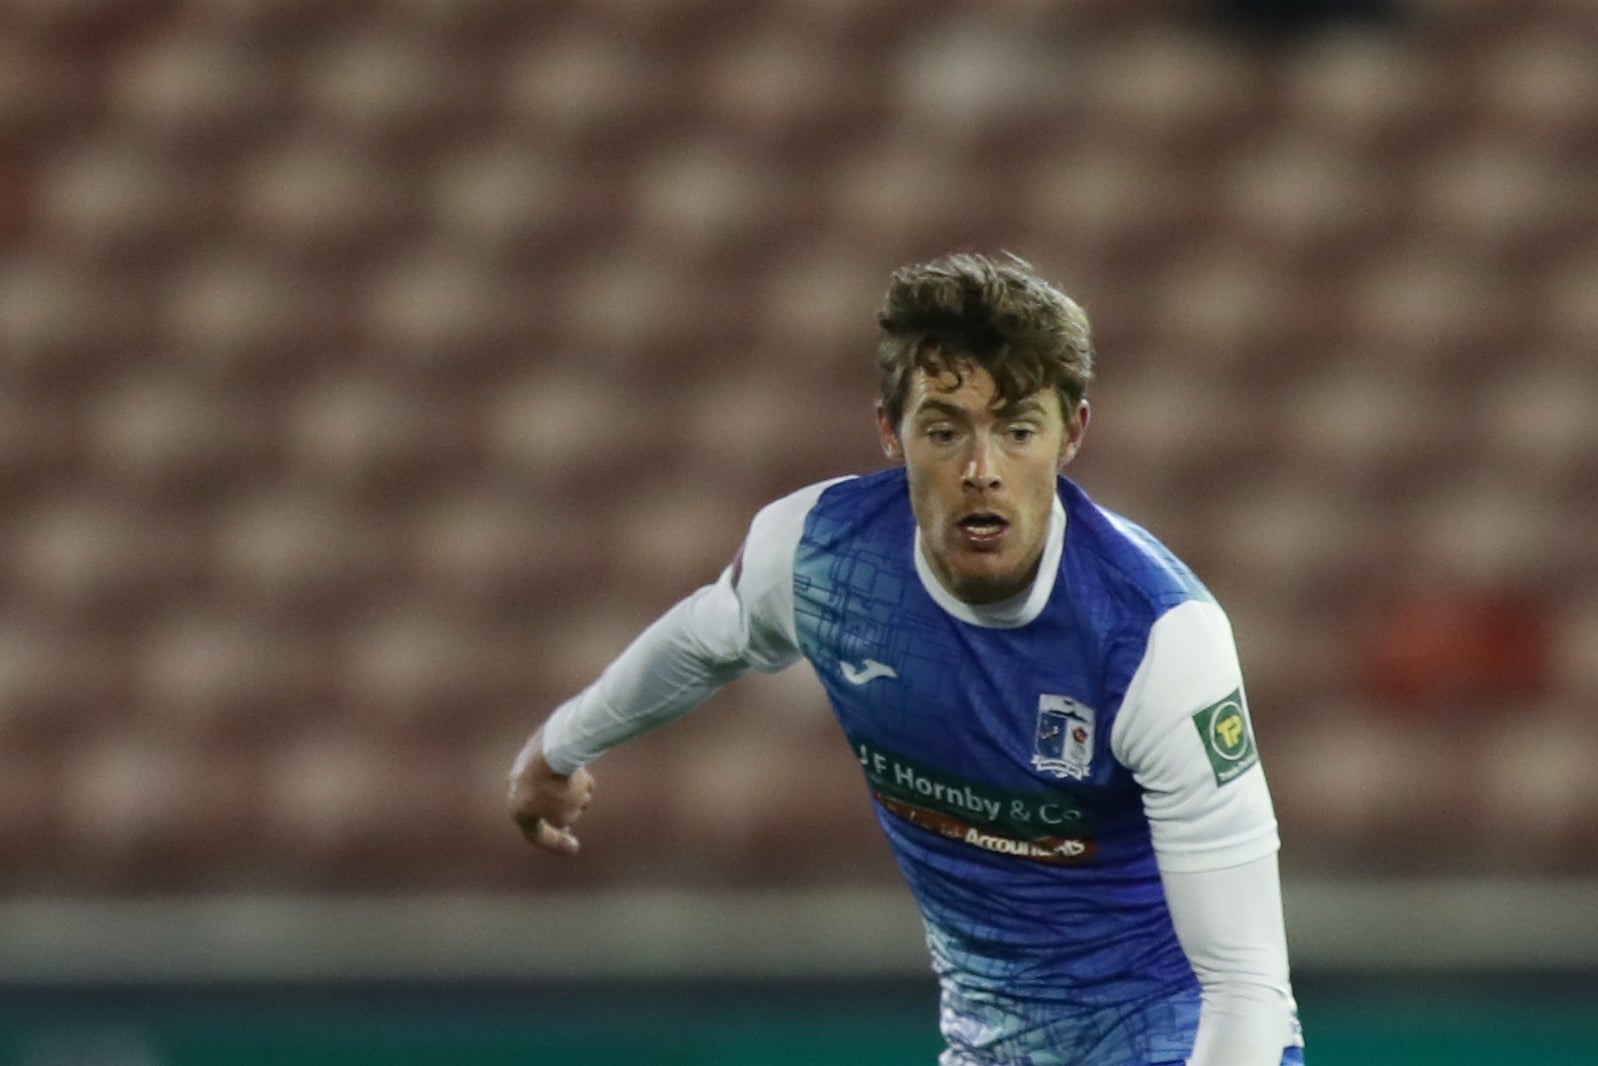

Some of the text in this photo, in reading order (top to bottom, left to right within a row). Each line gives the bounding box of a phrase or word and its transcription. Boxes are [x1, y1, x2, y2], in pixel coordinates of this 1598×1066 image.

[873, 753, 887, 774] F
[893, 763, 1001, 822] Hornby
[1009, 800, 1031, 822] &
